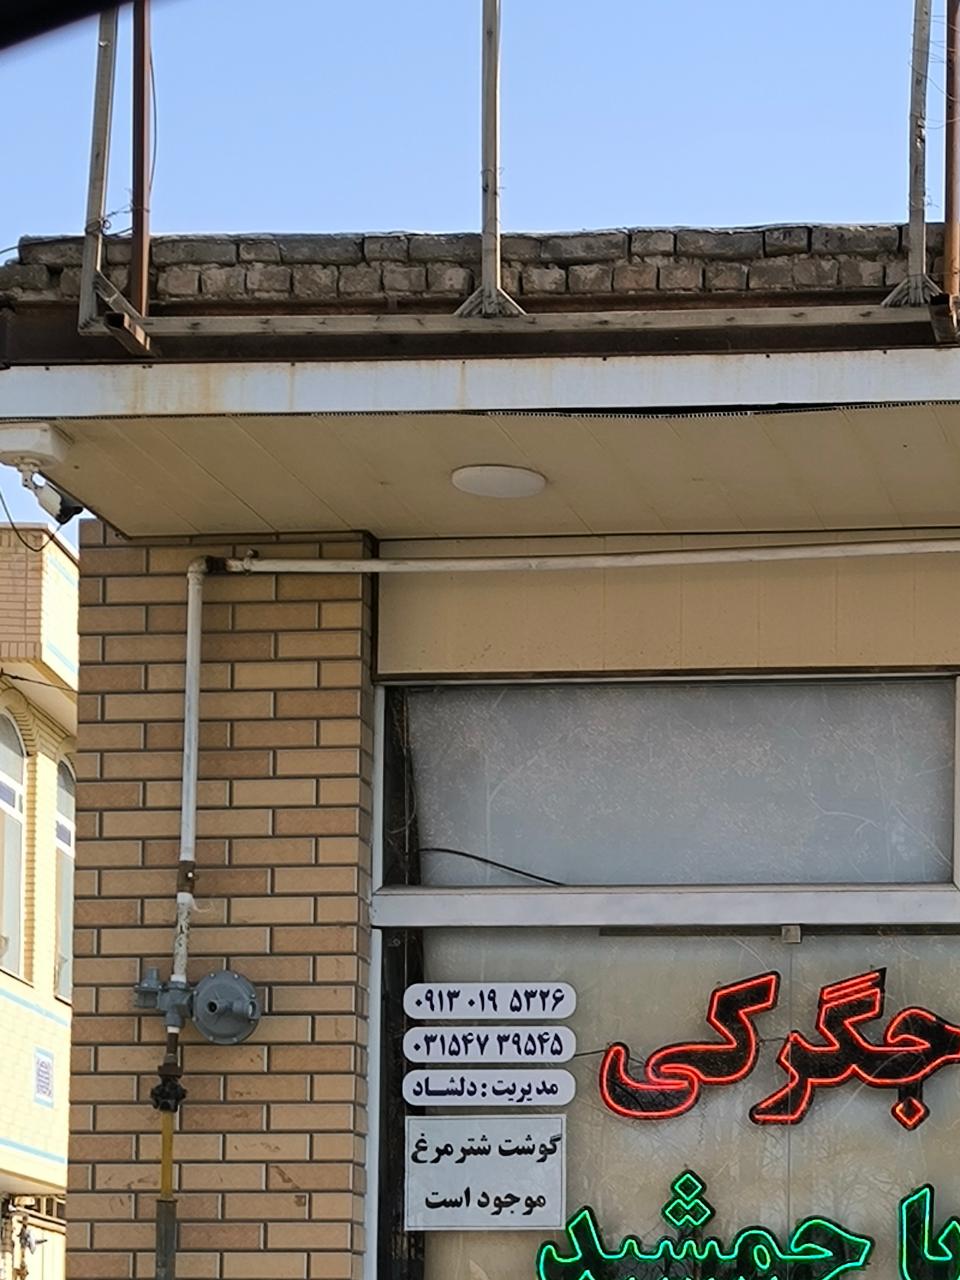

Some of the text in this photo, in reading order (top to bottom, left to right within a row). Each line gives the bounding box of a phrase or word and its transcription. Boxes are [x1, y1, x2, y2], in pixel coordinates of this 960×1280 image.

[497, 1133, 562, 1163] گوشت
[424, 1187, 547, 1216] موجود است
